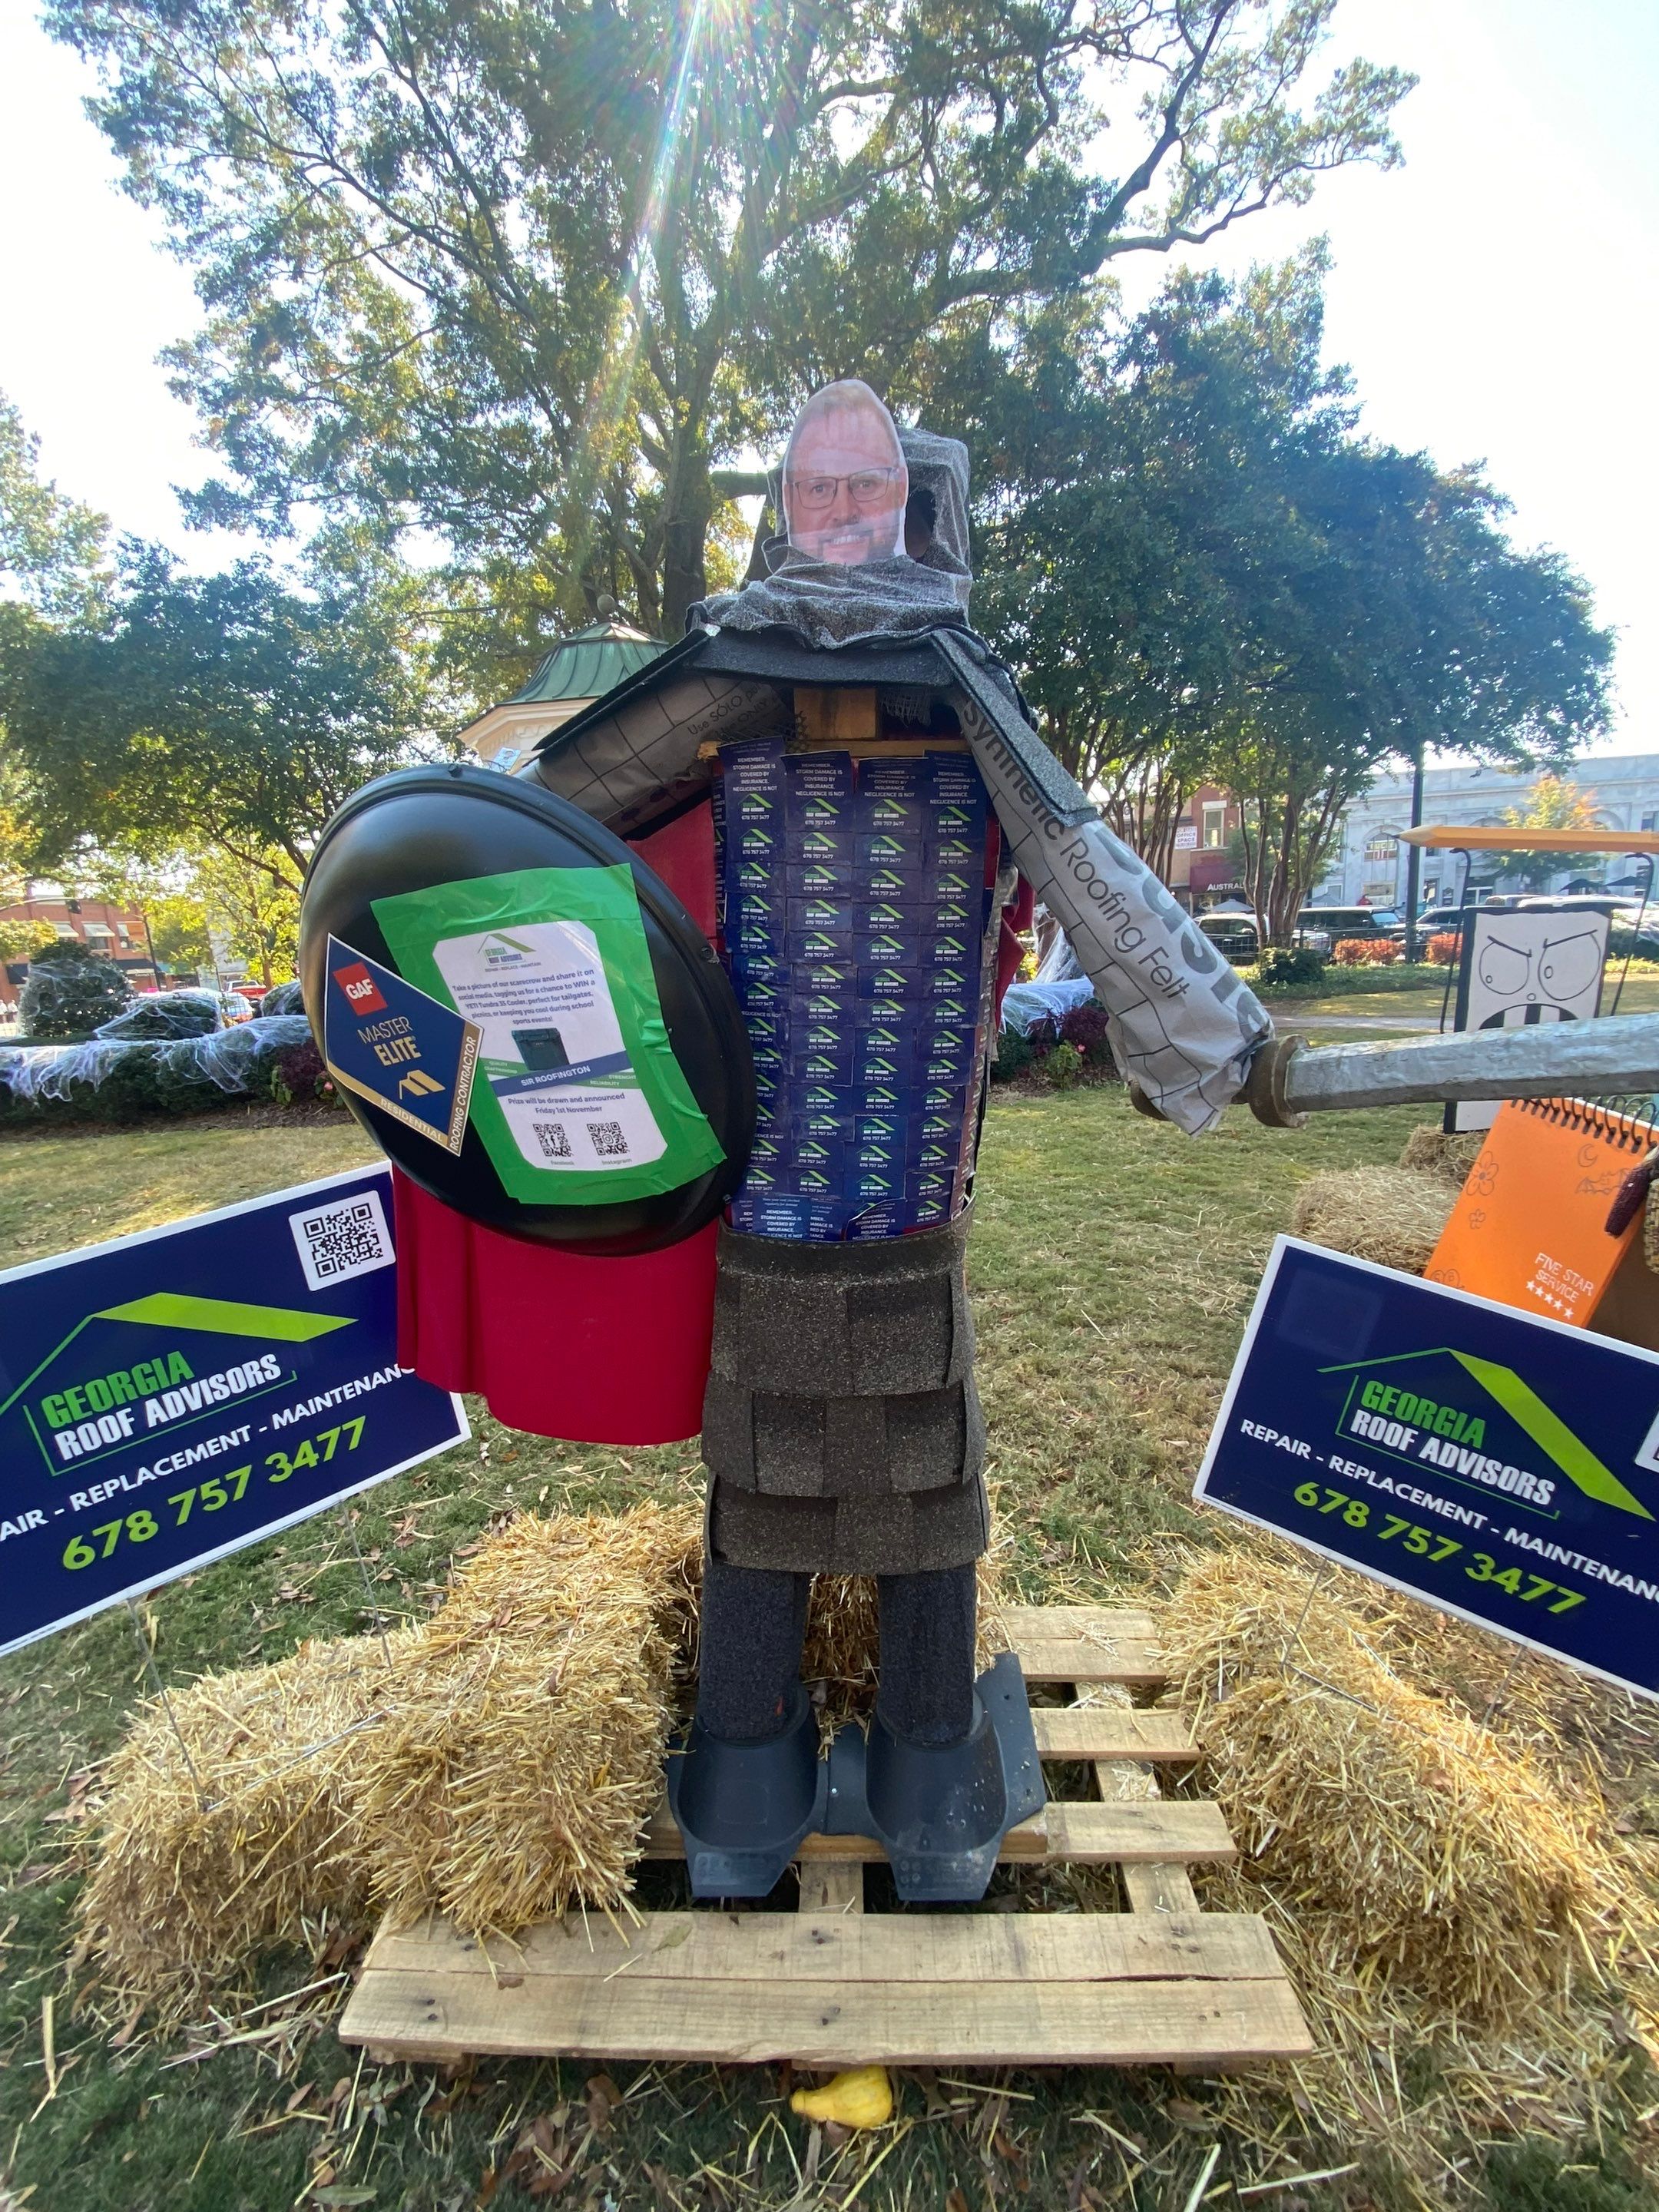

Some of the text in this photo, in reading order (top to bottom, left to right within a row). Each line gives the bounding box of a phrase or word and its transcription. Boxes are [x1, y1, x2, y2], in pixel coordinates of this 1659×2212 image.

[1060, 837, 1146, 953] Roofing
[1137, 946, 1190, 998] Felt
[346, 979, 374, 1000] GAF
[540, 985, 564, 993] chance
[573, 980, 589, 988] WIN
[542, 974, 555, 982] and
[556, 972, 576, 981] share
[499, 1008, 523, 1017] keeping
[571, 1001, 594, 1009] school
[528, 996, 550, 1005] perfect
[357, 1015, 413, 1044] MASTER
[449, 1035, 477, 1151] ROOFING CONTRACTOR
[521, 1065, 591, 1086] SIR ROOFINGTON
[535, 1107, 555, 1115] Friday
[567, 1105, 602, 1114] November
[584, 1093, 625, 1103] announced
[380, 1098, 443, 1143] RESIDENTIAL
[1535, 1252, 1594, 1296] FIVE STAR
[1535, 1270, 1579, 1303] SERVICE
[41, 1350, 195, 1429] GEORGIA
[55, 1353, 282, 1461] ROOF ADVISORS
[1360, 1380, 1486, 1449] GEORGIA
[69, 1425, 251, 1512] REPLACEMENT
[272, 1363, 416, 1430] MAINTENAN
[1349, 1409, 1556, 1505] ROOF ADVISORS
[63, 1416, 366, 1571] 678 757 3477
[1240, 1419, 1312, 1459] REPAIR
[1329, 1455, 1488, 1530] REPLACEMENT
[1293, 1482, 1587, 1614] 678 757 3477
